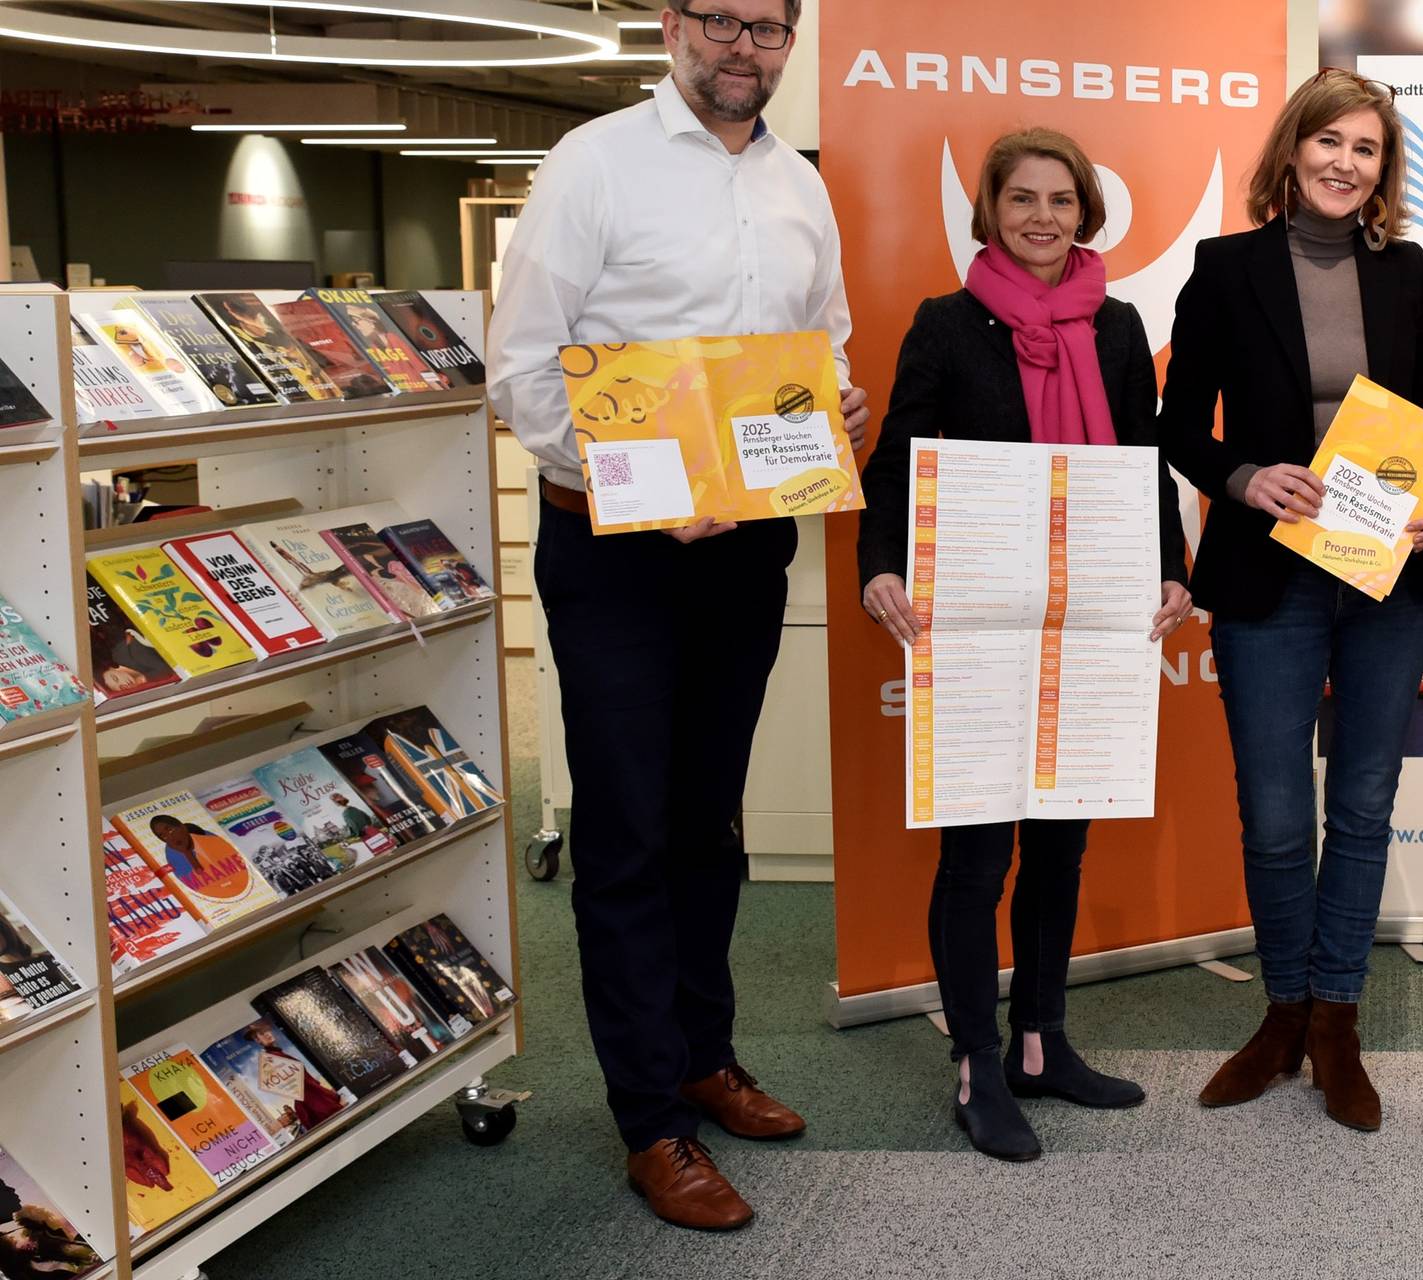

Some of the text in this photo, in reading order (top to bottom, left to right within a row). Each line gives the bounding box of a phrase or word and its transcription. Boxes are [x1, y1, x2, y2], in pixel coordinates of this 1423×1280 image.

[843, 49, 1259, 108] ARNSBERG
[318, 290, 373, 305] OKAYE
[159, 309, 198, 326] Der
[367, 348, 409, 363] TAGE
[421, 345, 478, 369] VIRTUA
[742, 423, 772, 436] 2025
[743, 432, 812, 444] Arnsberger Wochen
[742, 442, 819, 459] gegen Rassismus
[765, 452, 833, 466] für Demokratie
[1336, 464, 1364, 486] 2025
[781, 478, 831, 505] Programm
[1331, 475, 1392, 513] Arnsberger Wochen
[1324, 484, 1391, 526] gegen Rassismus
[1336, 501, 1396, 539] für Demokratie
[1324, 540, 1377, 558] Programm
[206, 553, 239, 568] VOM
[228, 578, 256, 590] DES
[8, 645, 29, 656] ICH
[16, 653, 47, 669] KANN
[125, 803, 160, 822] JESSICA
[181, 854, 247, 891] MAAME
[19, 961, 48, 979] Mutter
[131, 1050, 172, 1075] RASHA
[154, 1053, 200, 1082] KHAYAT
[190, 1118, 217, 1137] ICH
[190, 1124, 239, 1157] KOMME
[224, 1129, 263, 1157] NICHT
[214, 1148, 265, 1184] ZURÜCK
